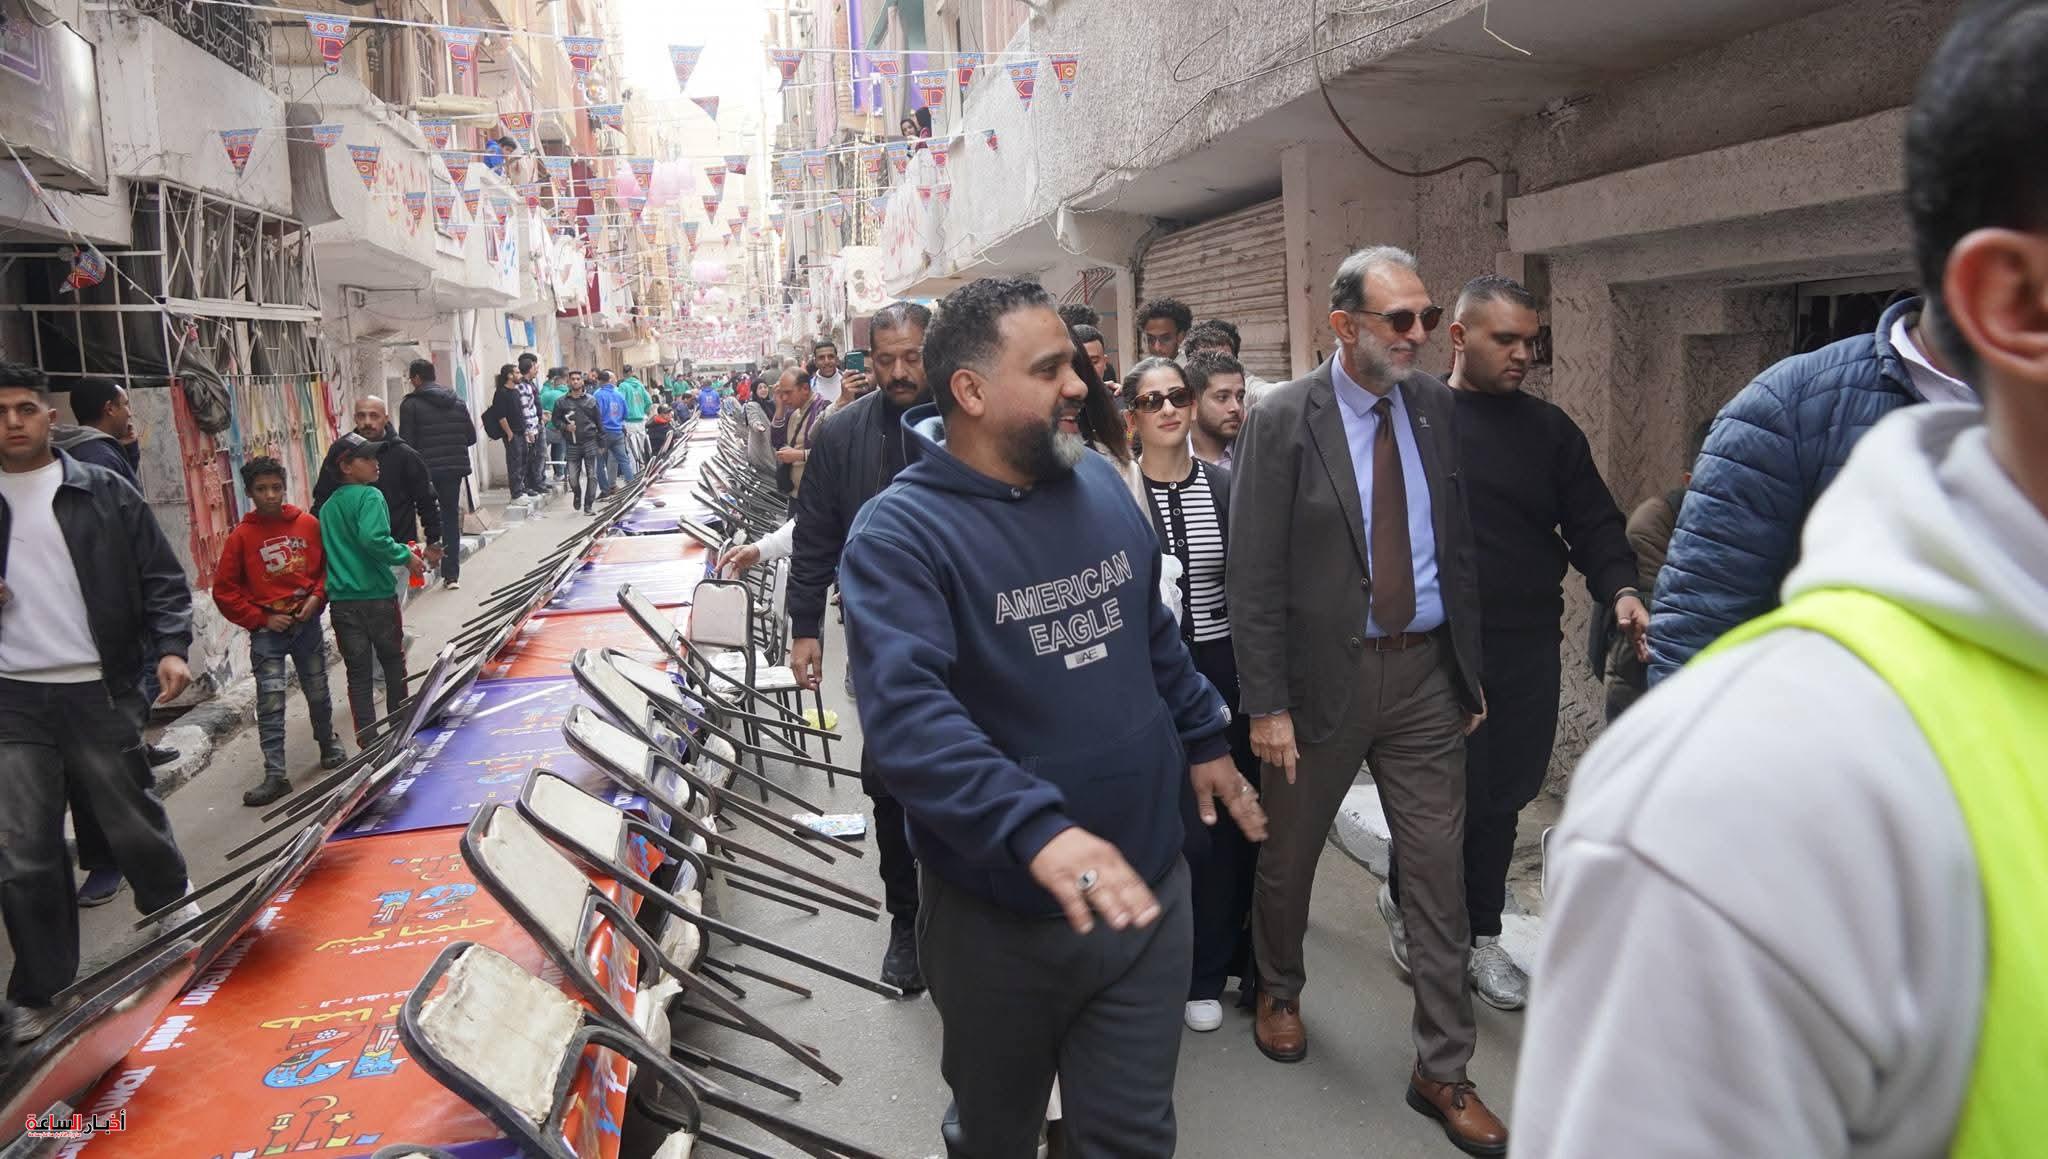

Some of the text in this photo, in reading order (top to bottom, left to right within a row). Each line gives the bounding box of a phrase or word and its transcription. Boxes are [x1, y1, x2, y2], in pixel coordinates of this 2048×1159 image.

[995, 550, 1133, 624] AMERICAN
[1029, 598, 1123, 656] EAGLE
[314, 917, 495, 952] حلمنا كبير
[259, 1007, 374, 1029] حلمنا
